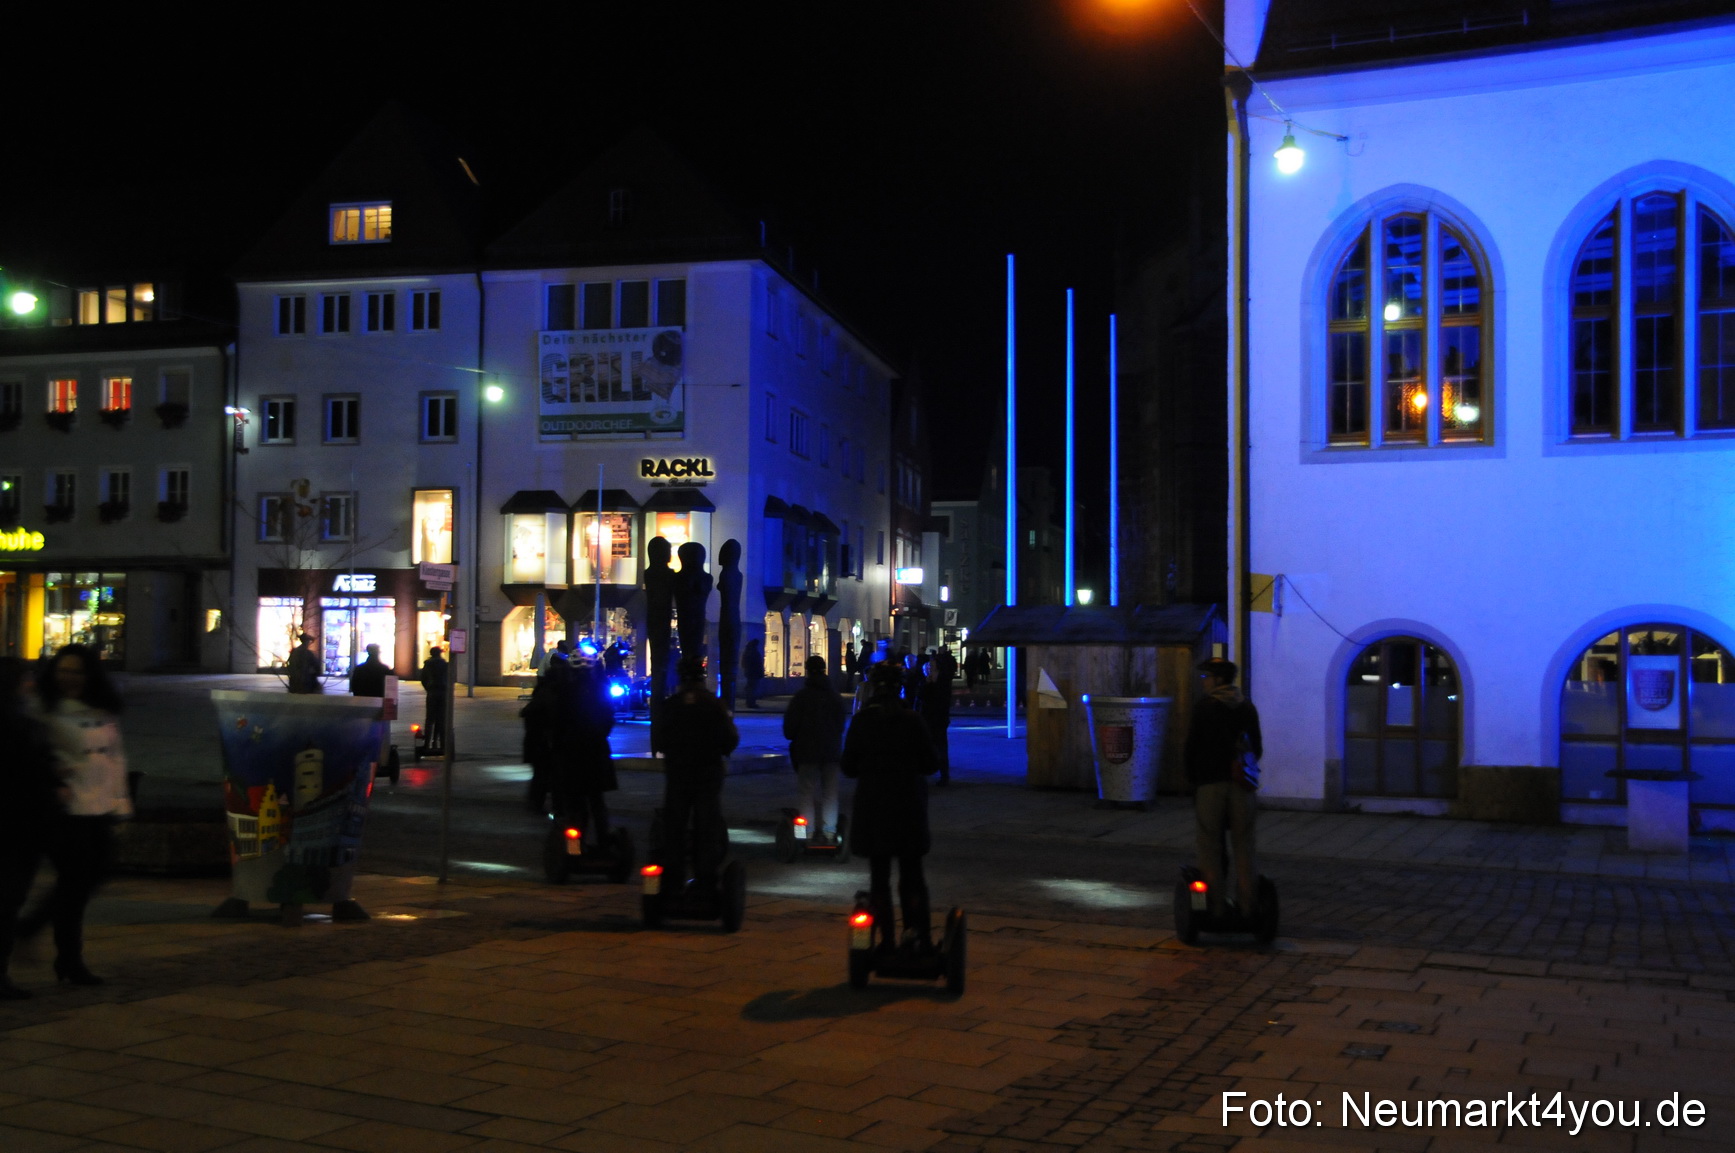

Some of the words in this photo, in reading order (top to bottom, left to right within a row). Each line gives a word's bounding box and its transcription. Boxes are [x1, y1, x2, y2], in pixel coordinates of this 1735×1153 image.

[542, 334, 575, 345] Dein
[583, 333, 648, 344] nächster
[542, 419, 633, 431] OUTDOORCHEF
[641, 458, 714, 477] RACKL
